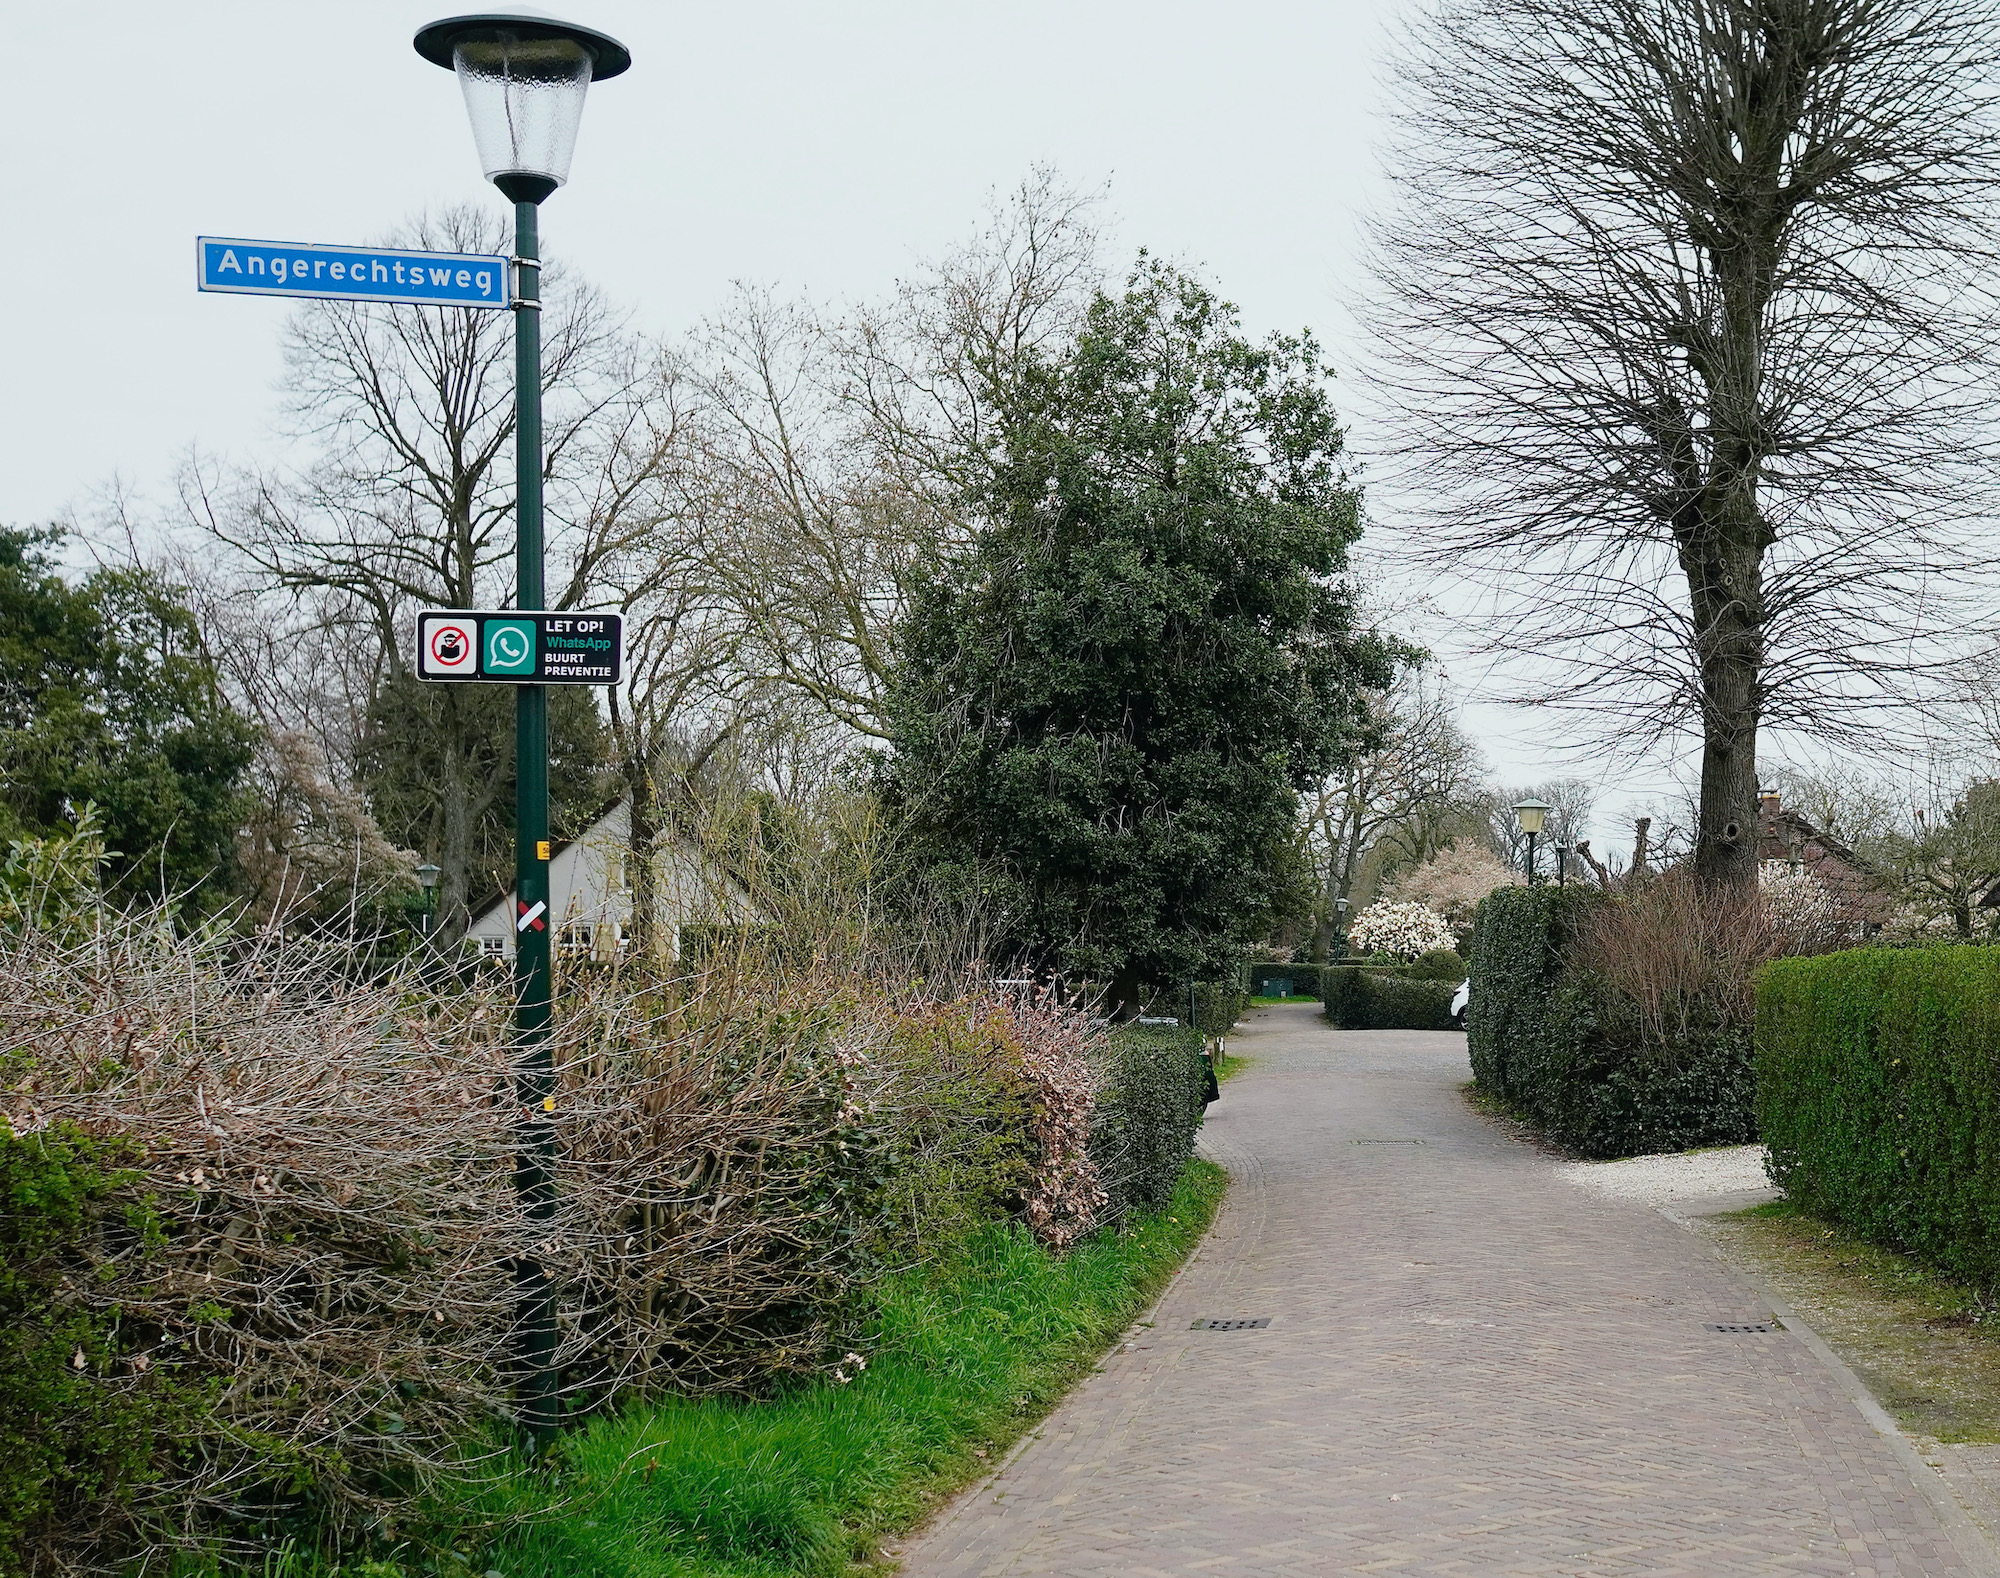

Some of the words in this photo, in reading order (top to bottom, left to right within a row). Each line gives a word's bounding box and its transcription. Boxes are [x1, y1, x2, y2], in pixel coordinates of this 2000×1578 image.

[217, 249, 493, 297] Angerechtsweg
[545, 620, 573, 632] LET
[577, 620, 604, 633] OP!
[546, 636, 612, 651] WhatsApp
[545, 653, 585, 663] BUURT
[544, 666, 612, 677] PREVENTIE
